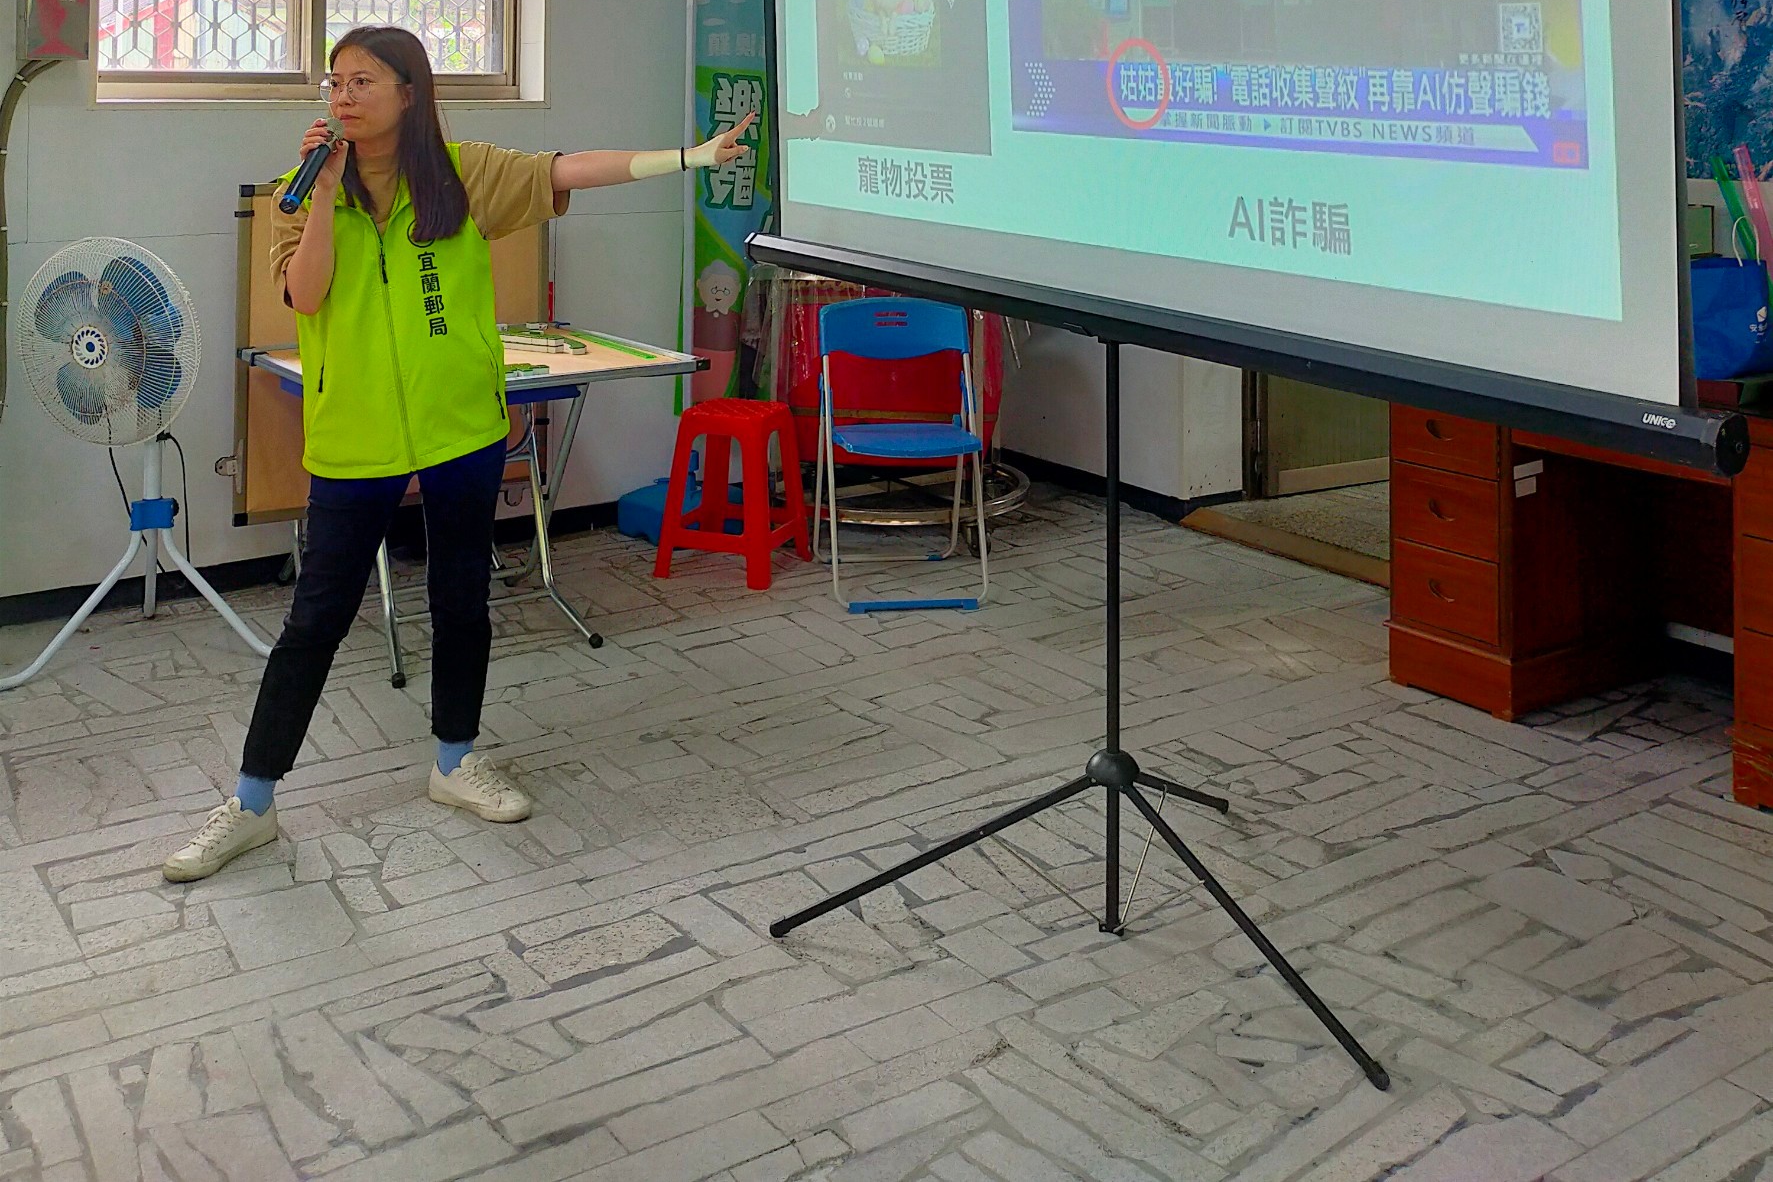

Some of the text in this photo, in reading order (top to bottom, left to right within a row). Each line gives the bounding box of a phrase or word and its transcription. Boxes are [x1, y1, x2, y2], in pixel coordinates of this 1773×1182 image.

[857, 155, 955, 205] 寵物投票
[1227, 196, 1352, 256] AI詐騙
[417, 250, 448, 338] 宜蘭郵局
